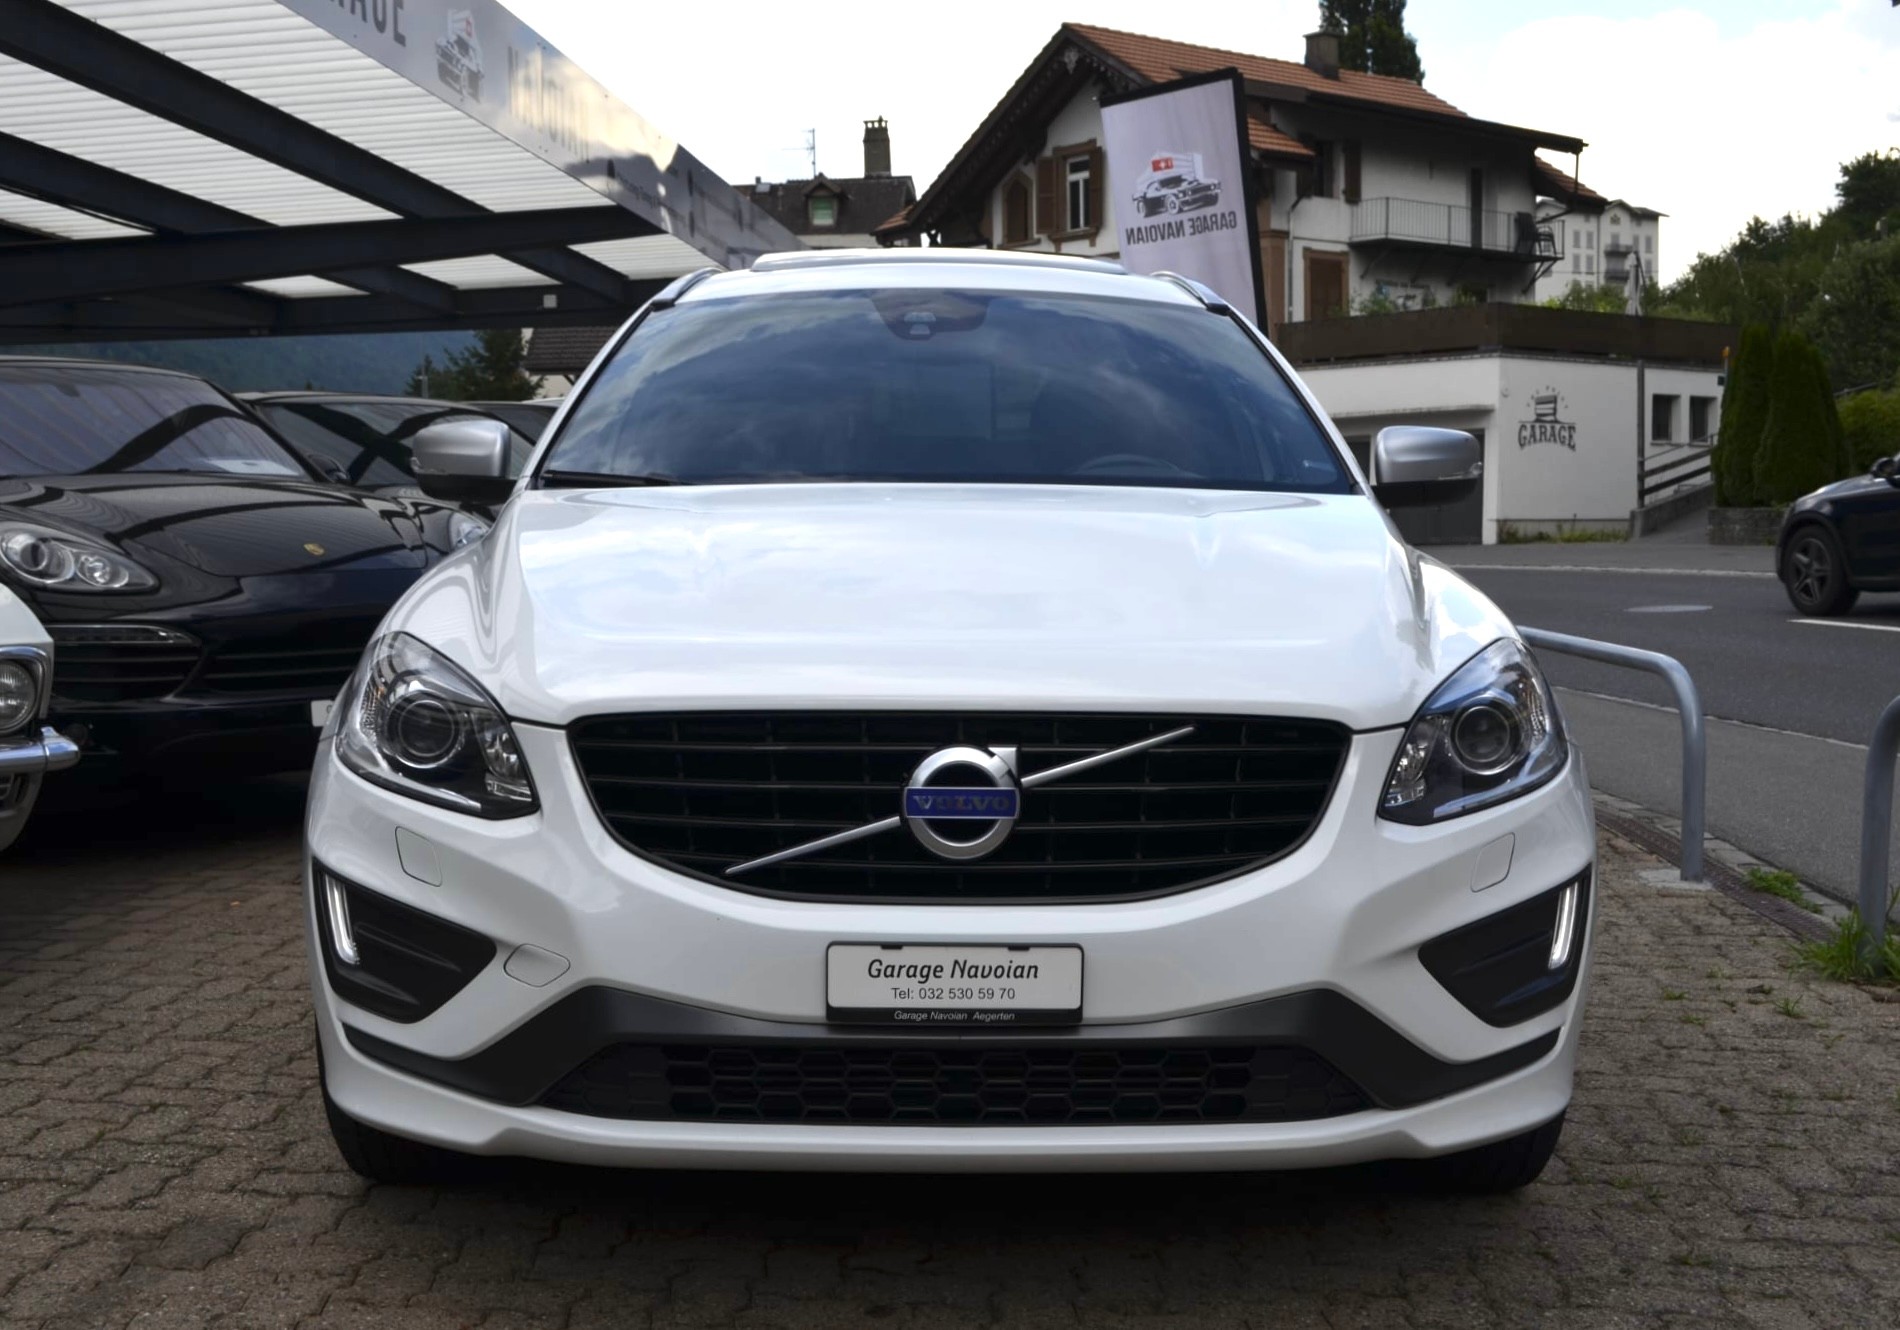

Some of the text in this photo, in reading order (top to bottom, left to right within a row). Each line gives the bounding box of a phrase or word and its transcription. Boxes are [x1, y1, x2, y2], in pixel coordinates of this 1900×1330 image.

[1518, 424, 1576, 452] GARAGE
[912, 795, 1010, 811] VOLVO
[867, 958, 1039, 984] Garage Navoian
[891, 987, 1016, 1000] Tel: 032 530 59 70
[894, 1010, 1015, 1023] Garage Navoian Aegerten
